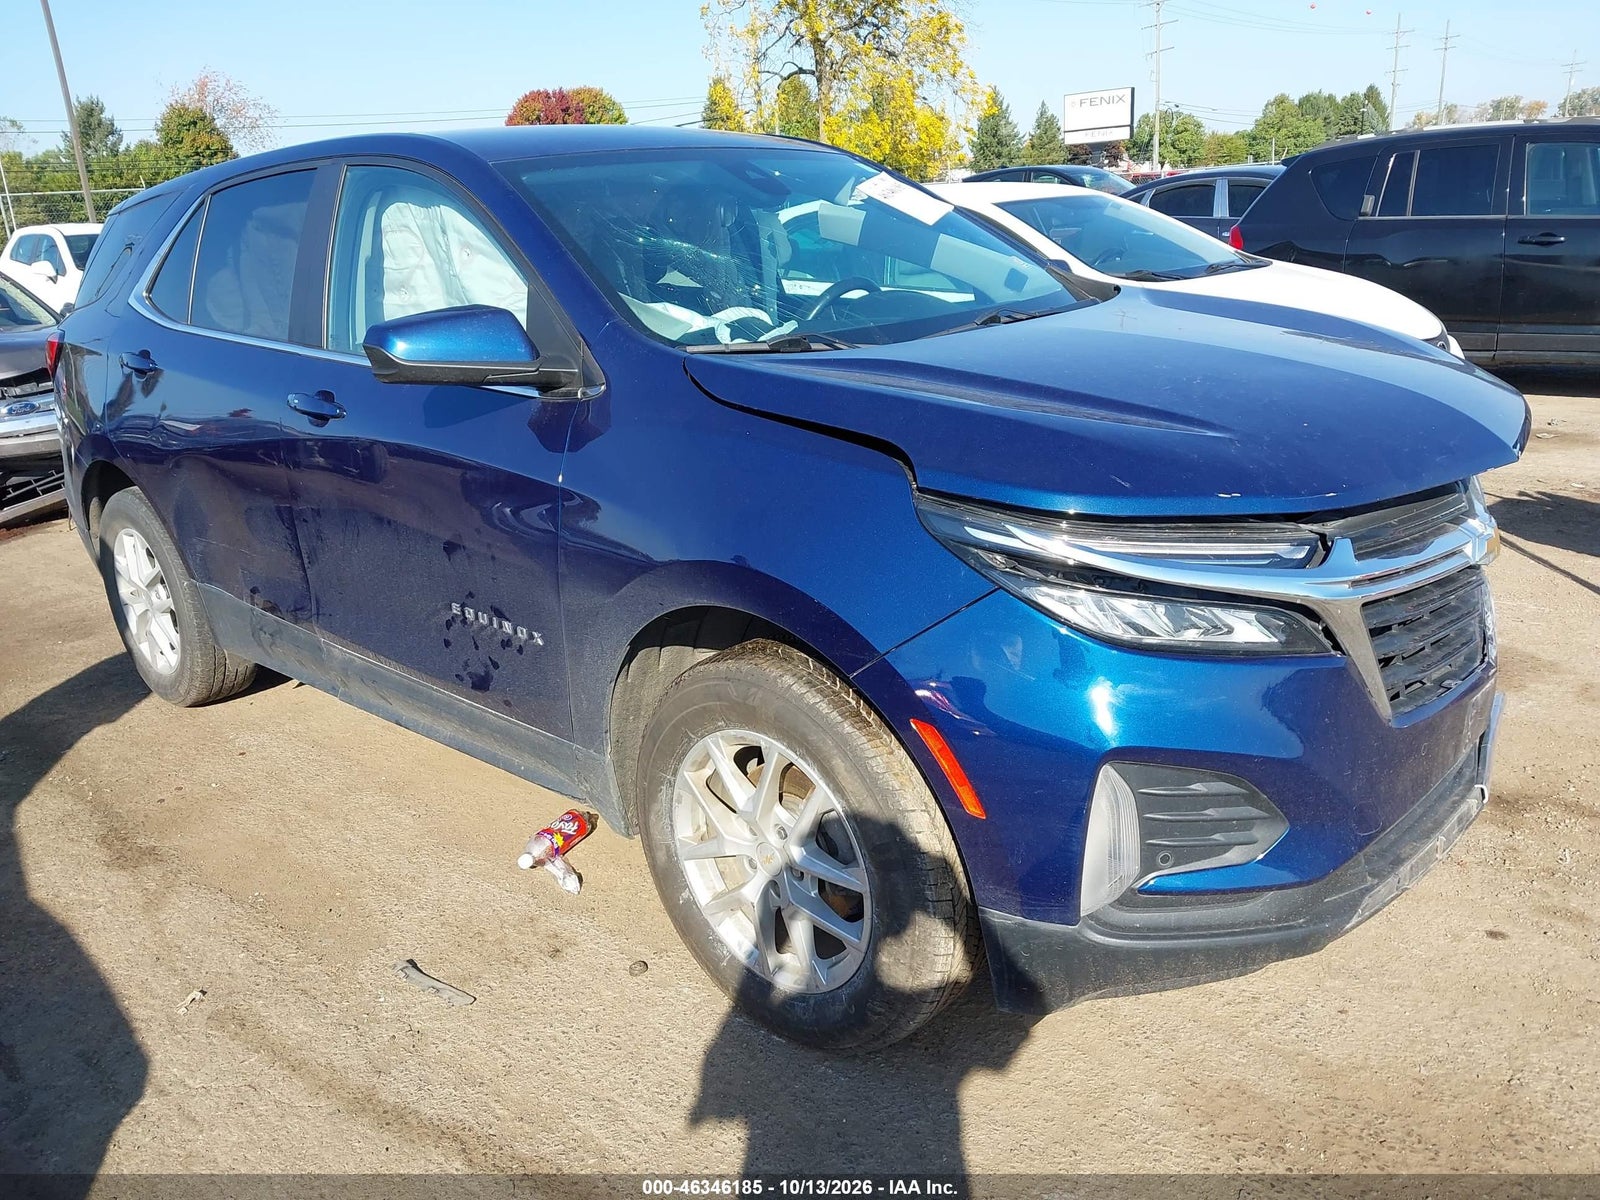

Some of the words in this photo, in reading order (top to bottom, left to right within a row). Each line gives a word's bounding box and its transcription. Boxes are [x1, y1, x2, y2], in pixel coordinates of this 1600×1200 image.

[1079, 94, 1126, 108] FENIX
[11, 402, 32, 414] Ford
[450, 602, 544, 646] EQUINOX
